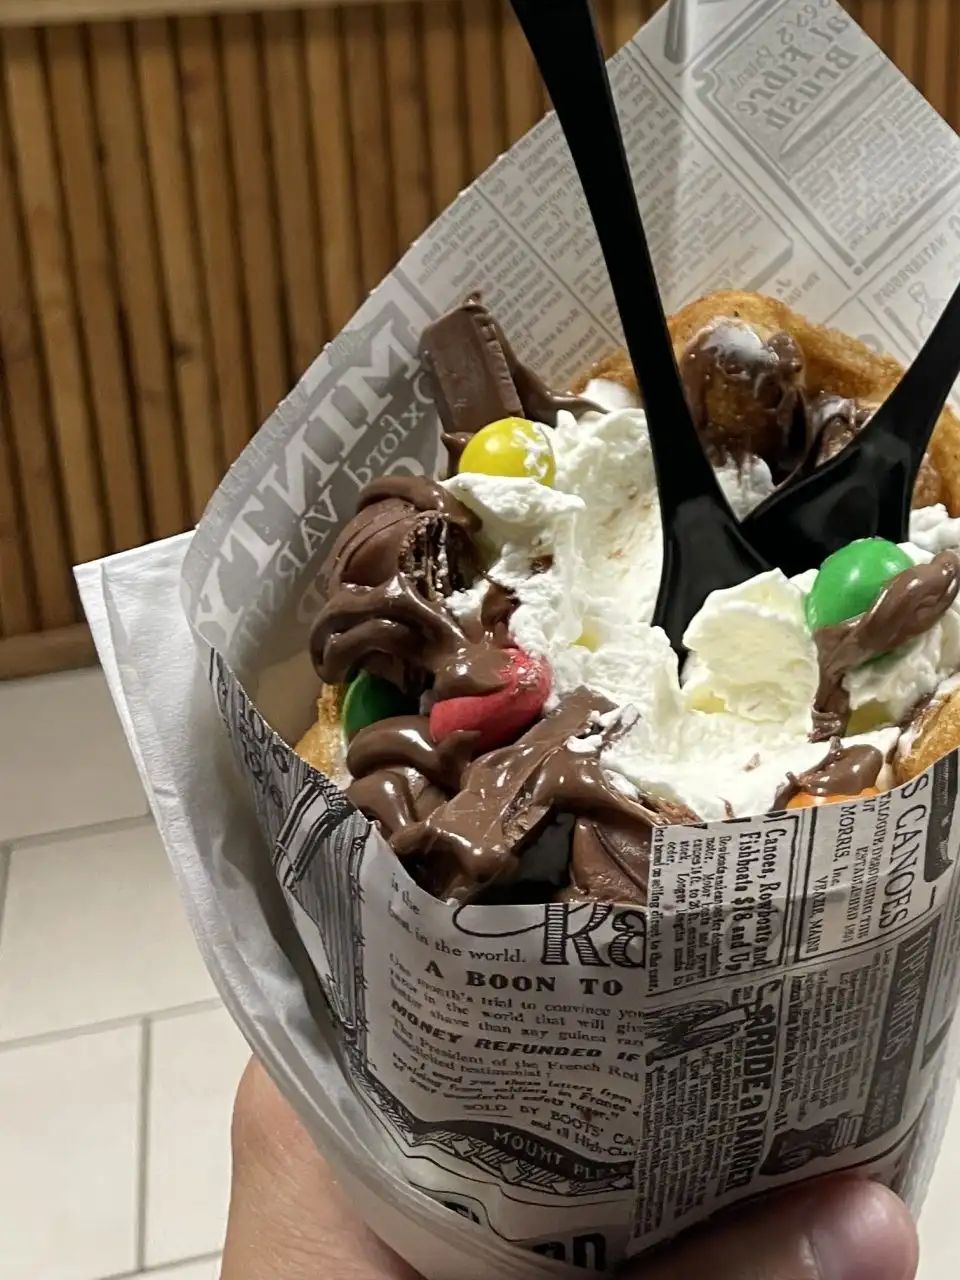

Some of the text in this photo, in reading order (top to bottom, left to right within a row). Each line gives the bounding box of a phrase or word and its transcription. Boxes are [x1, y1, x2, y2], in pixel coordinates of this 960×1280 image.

[734, 831, 761, 892] Fishboats
[879, 804, 927, 929] CANOES
[730, 896, 757, 920] $18
[752, 828, 788, 967] Canoes, Rowboats and
[730, 926, 751, 948] and
[806, 918, 823, 954] MAINE
[435, 939, 463, 958] the
[467, 948, 526, 963] world.
[725, 952, 756, 972] Up
[424, 960, 624, 996] A BOON TO
[446, 1002, 470, 1015] the
[577, 1019, 605, 1030] will
[481, 997, 513, 1008] trial
[521, 1001, 537, 1011] to
[544, 1004, 611, 1017] convince
[391, 998, 642, 1062] MONEY REFUNDED IF
[478, 1021, 512, 1034] than
[520, 1028, 549, 1040] any
[558, 1031, 607, 1043] guinea
[608, 1065, 639, 1082] Red
[492, 1127, 565, 1166] MOUNT
